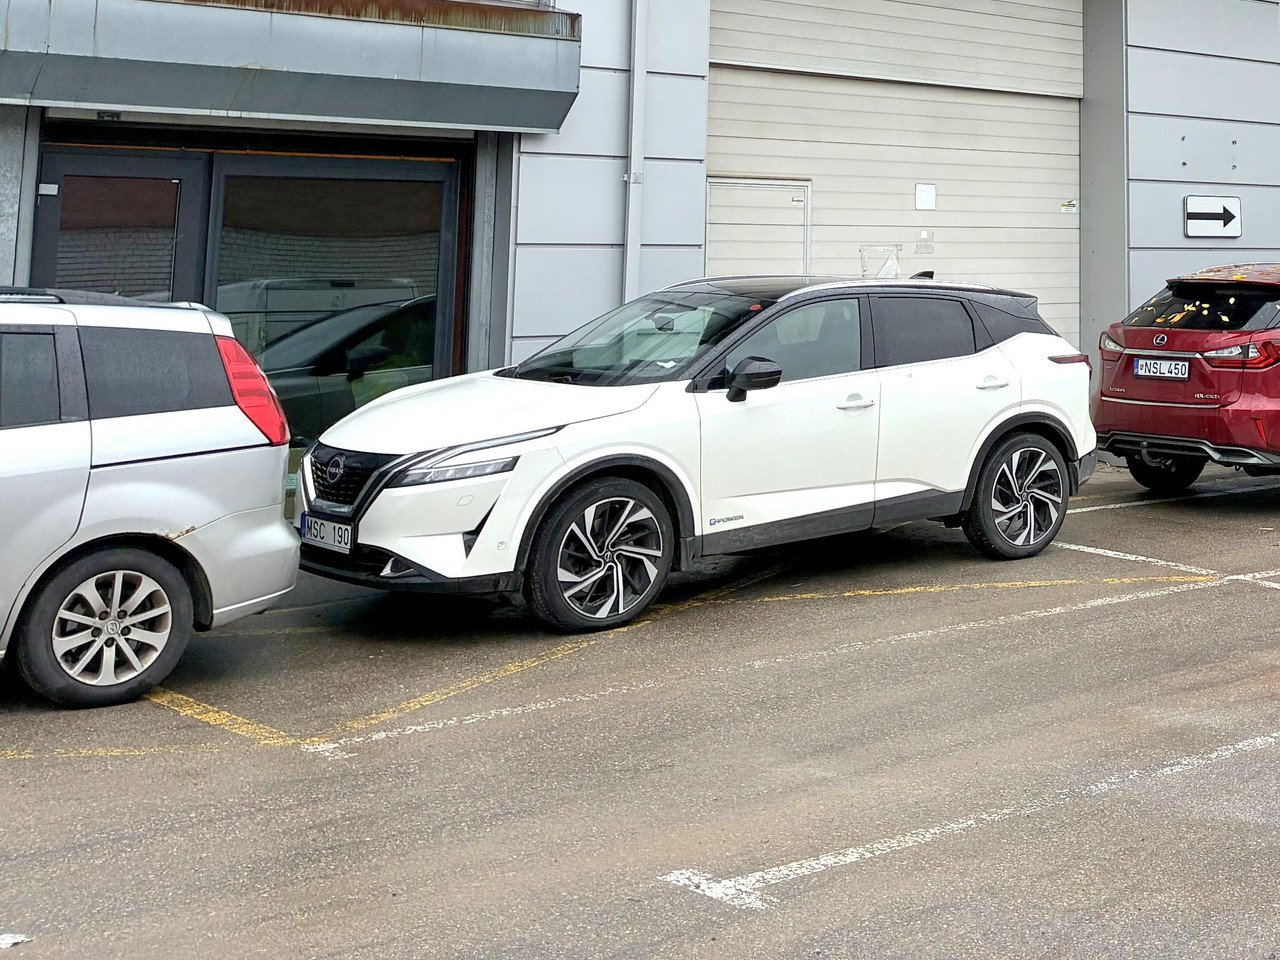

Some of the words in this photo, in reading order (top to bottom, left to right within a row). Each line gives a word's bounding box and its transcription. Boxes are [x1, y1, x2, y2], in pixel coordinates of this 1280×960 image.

[1144, 361, 1165, 375] NSL
[1167, 362, 1187, 376] 450
[307, 519, 326, 540] MSC
[332, 525, 350, 546] 190
